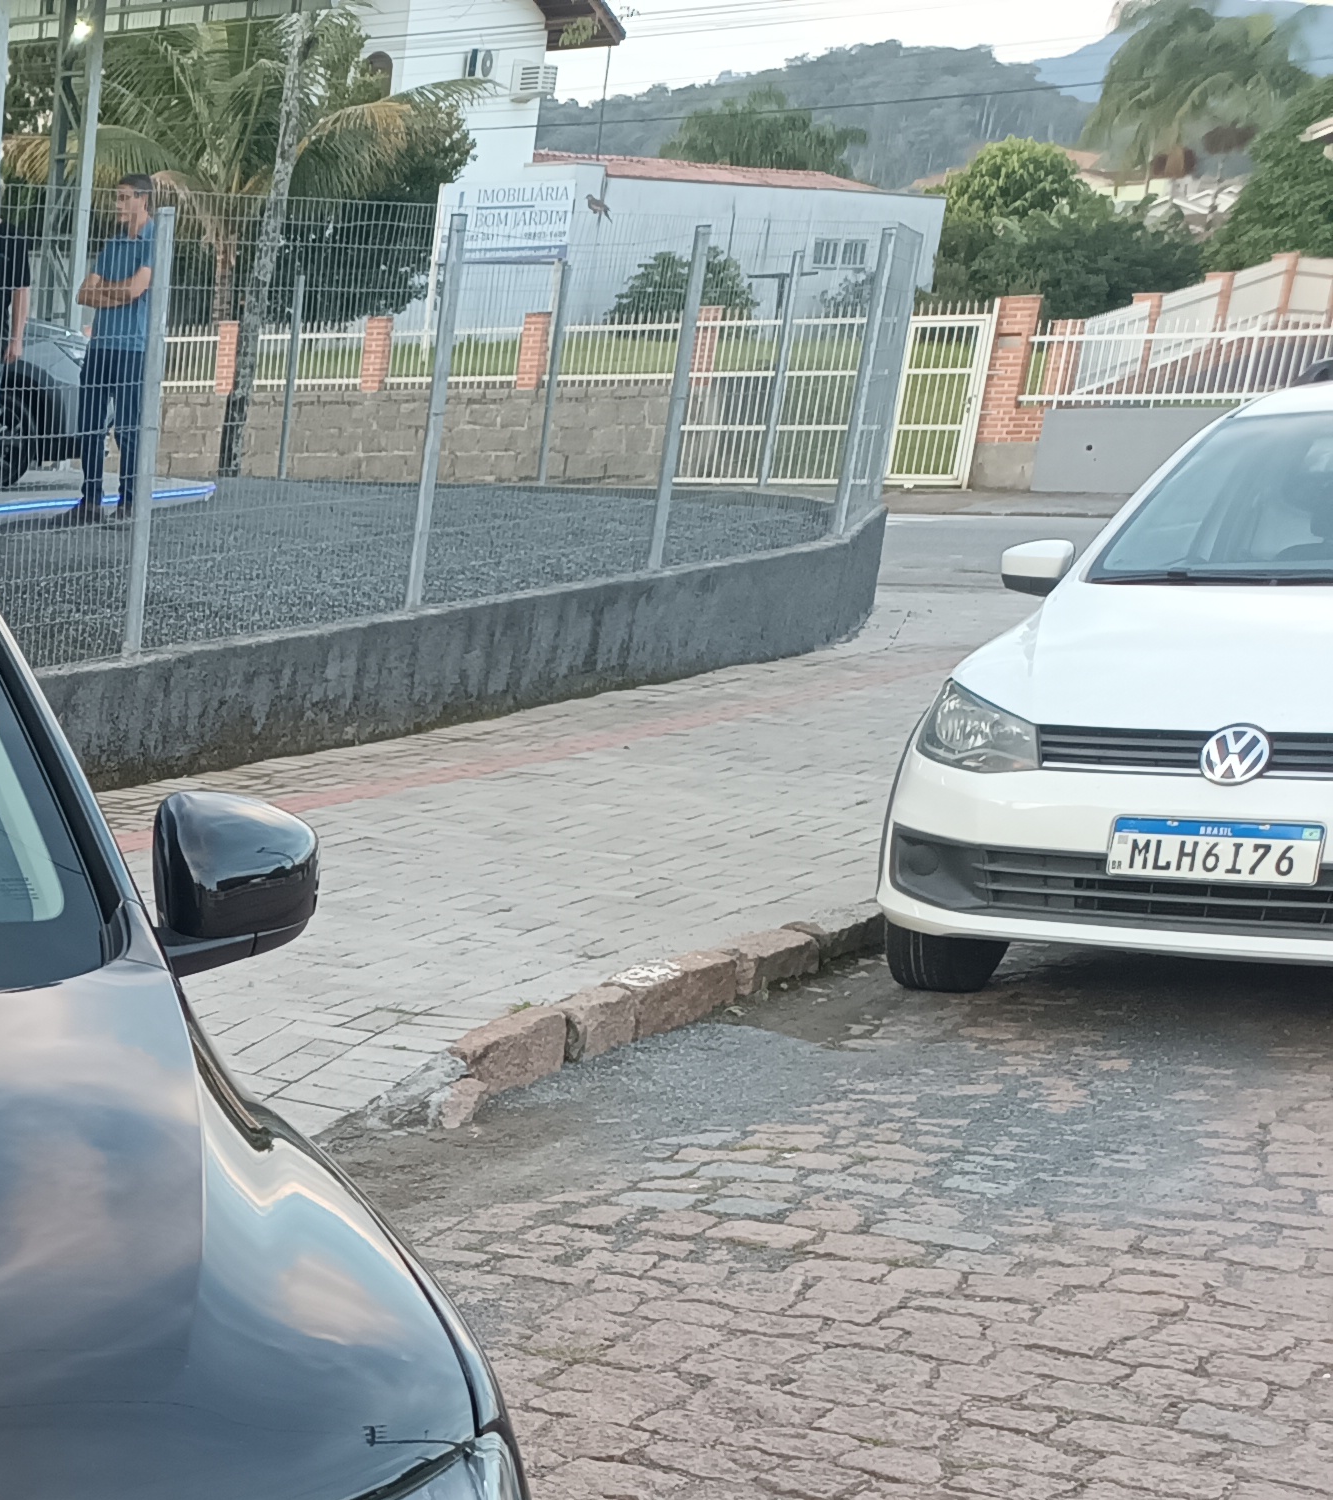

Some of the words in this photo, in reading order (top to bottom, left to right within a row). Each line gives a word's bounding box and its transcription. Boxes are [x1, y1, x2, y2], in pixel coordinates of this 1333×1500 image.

[477, 183, 570, 203] IMOBILIÁRIA
[475, 212, 508, 228] BOM
[512, 210, 568, 229] JARDIM
[1199, 826, 1233, 836] BRASIL
